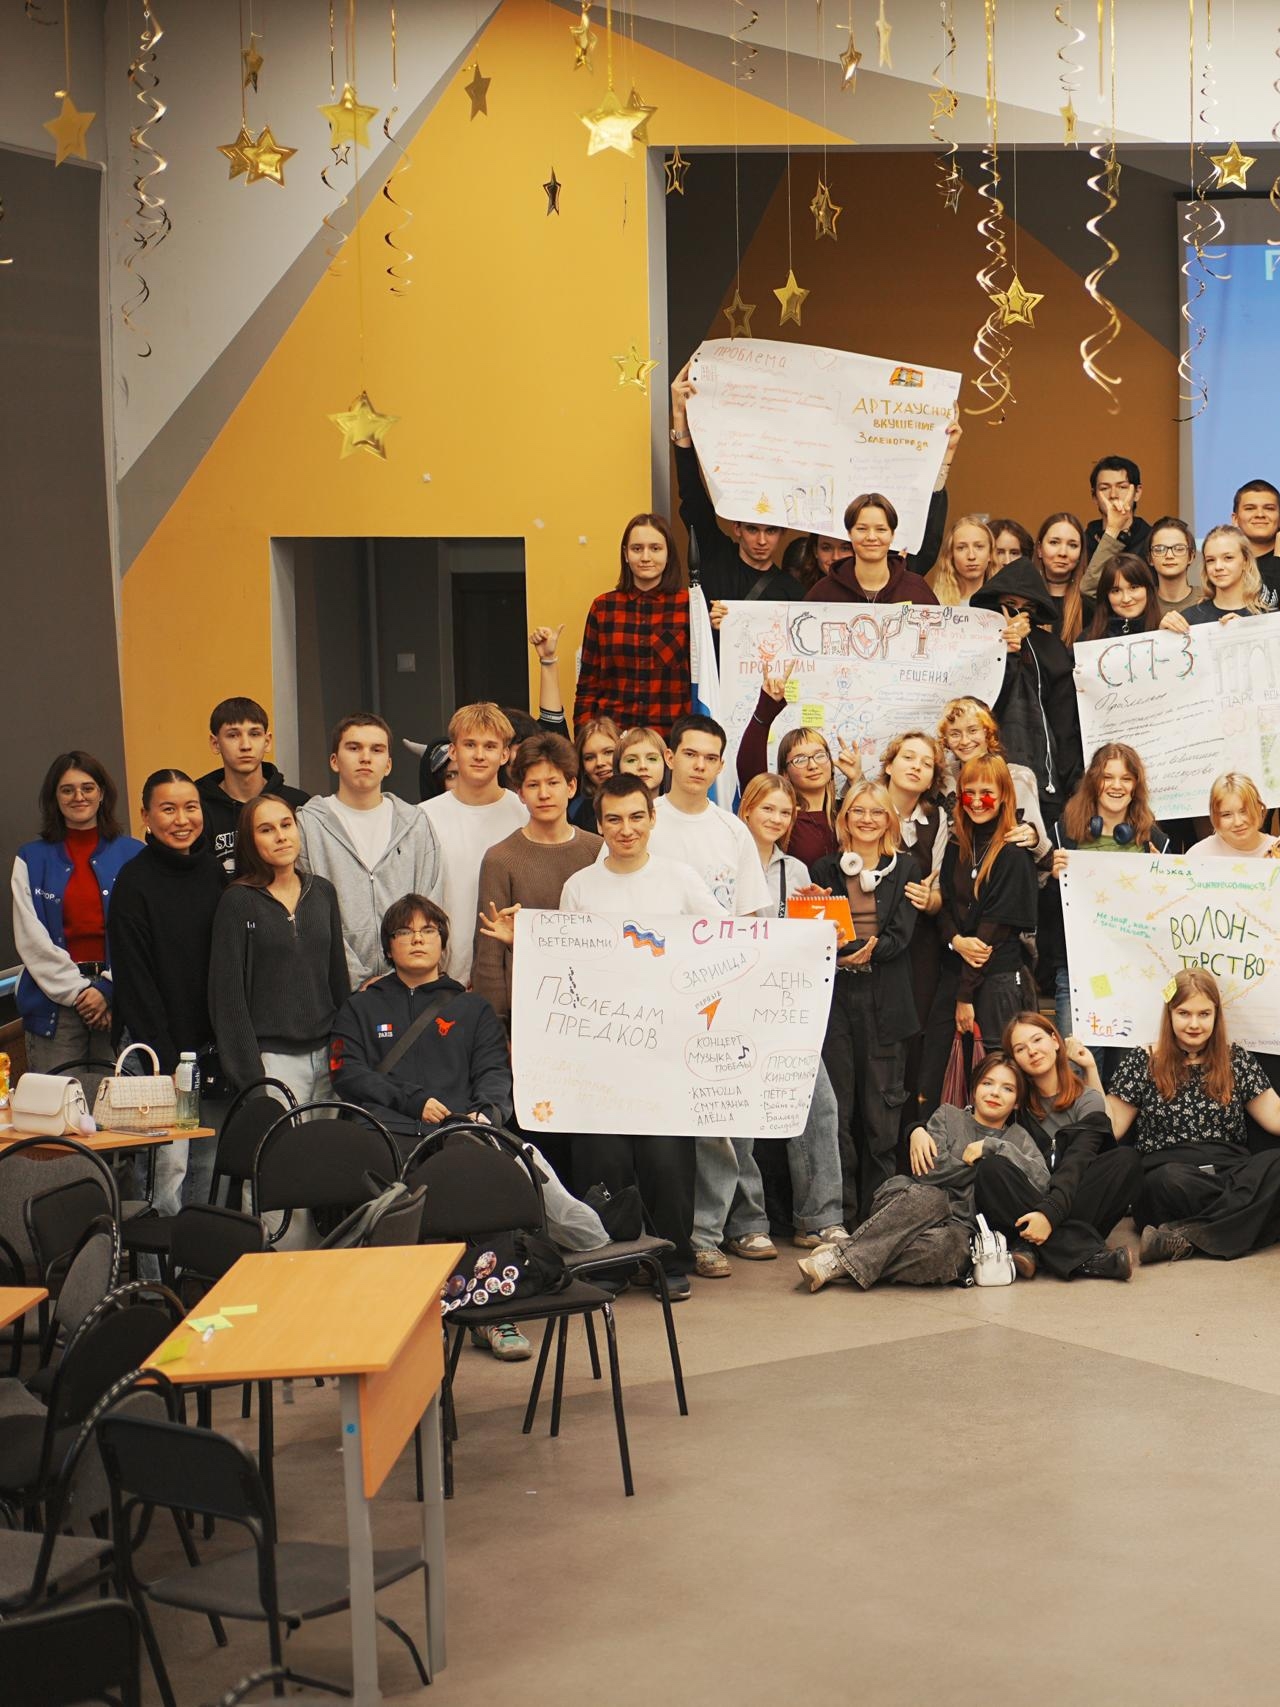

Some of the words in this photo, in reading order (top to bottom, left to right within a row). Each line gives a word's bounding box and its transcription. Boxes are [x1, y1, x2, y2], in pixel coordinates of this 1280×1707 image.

[789, 604, 953, 661] СПОРТ
[1097, 632, 1196, 687] СП-3
[899, 668, 950, 684] РЕШЕНИЯ
[540, 913, 594, 926] ВСТРЕЧА
[559, 925, 569, 935] С
[692, 919, 769, 945] СП-11
[1169, 905, 1260, 951] ВОЛОН-
[538, 936, 612, 949] ВЕТЕРАНАМИ
[760, 971, 813, 991] ДЕНЬ
[781, 989, 796, 1008] В
[752, 1008, 810, 1024] МУЗЕЕ
[545, 1011, 659, 1050] ПРЕДКОВ
[696, 1033, 744, 1049] КОНЦЕРТ
[687, 1051, 734, 1064] МУЗЫКА
[715, 1061, 752, 1073] ПОБЕДЫ
[691, 1085, 742, 1100] КАТЮША
